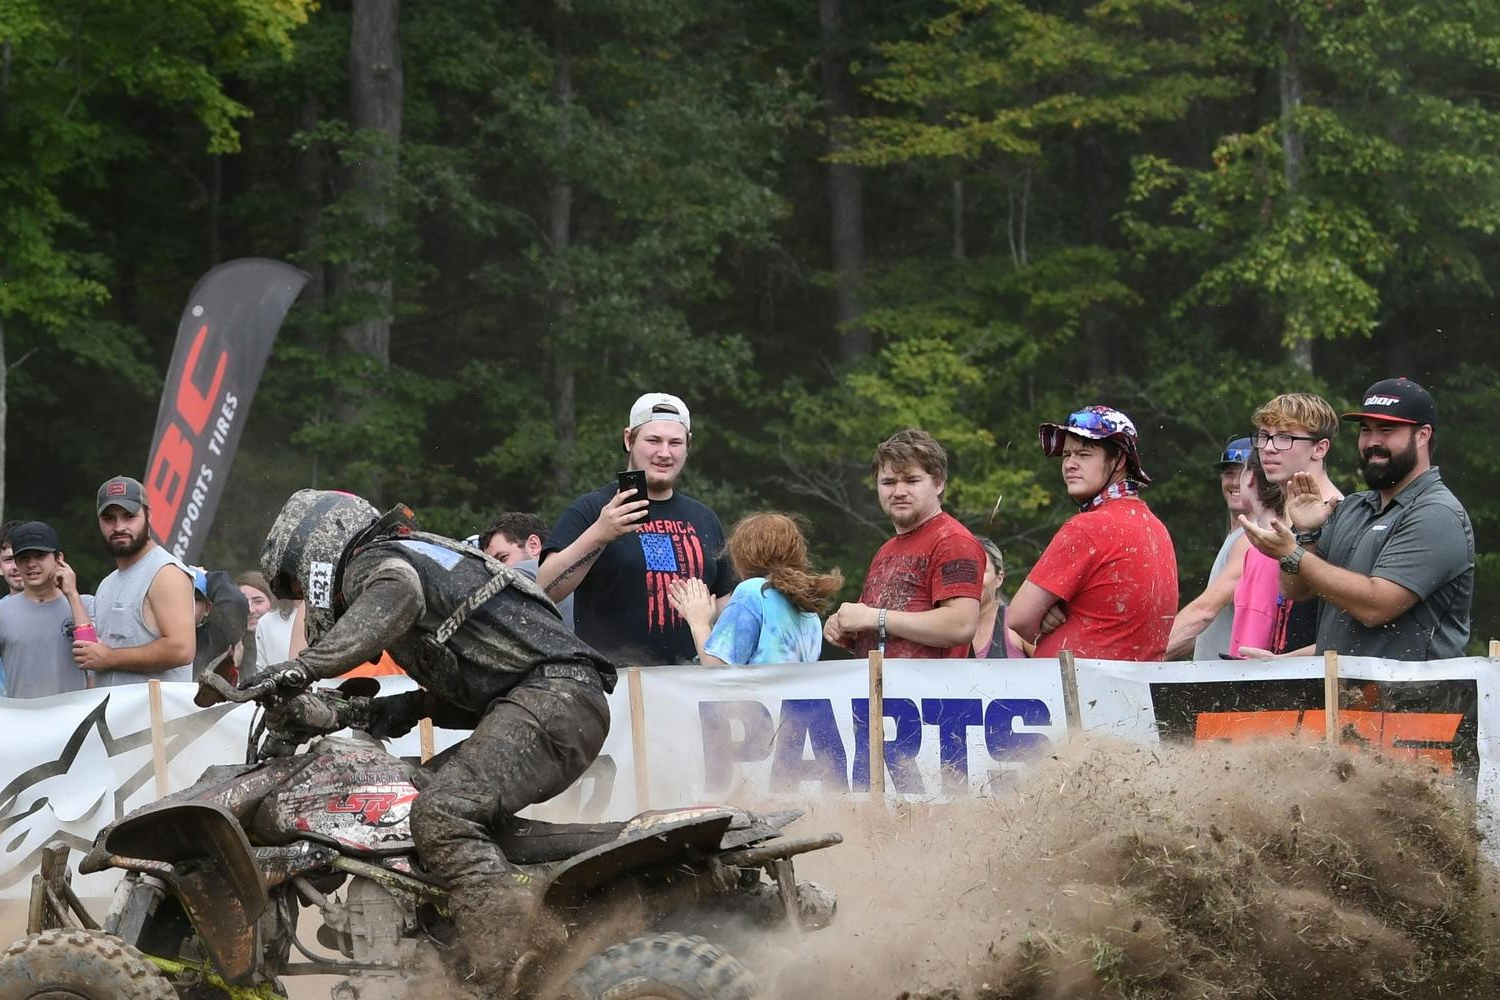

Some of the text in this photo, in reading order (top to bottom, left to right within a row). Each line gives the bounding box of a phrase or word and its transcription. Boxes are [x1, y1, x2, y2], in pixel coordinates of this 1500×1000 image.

[208, 391, 239, 456] TIRES
[636, 519, 696, 534] AMERICA
[698, 697, 1056, 800] PARTS
